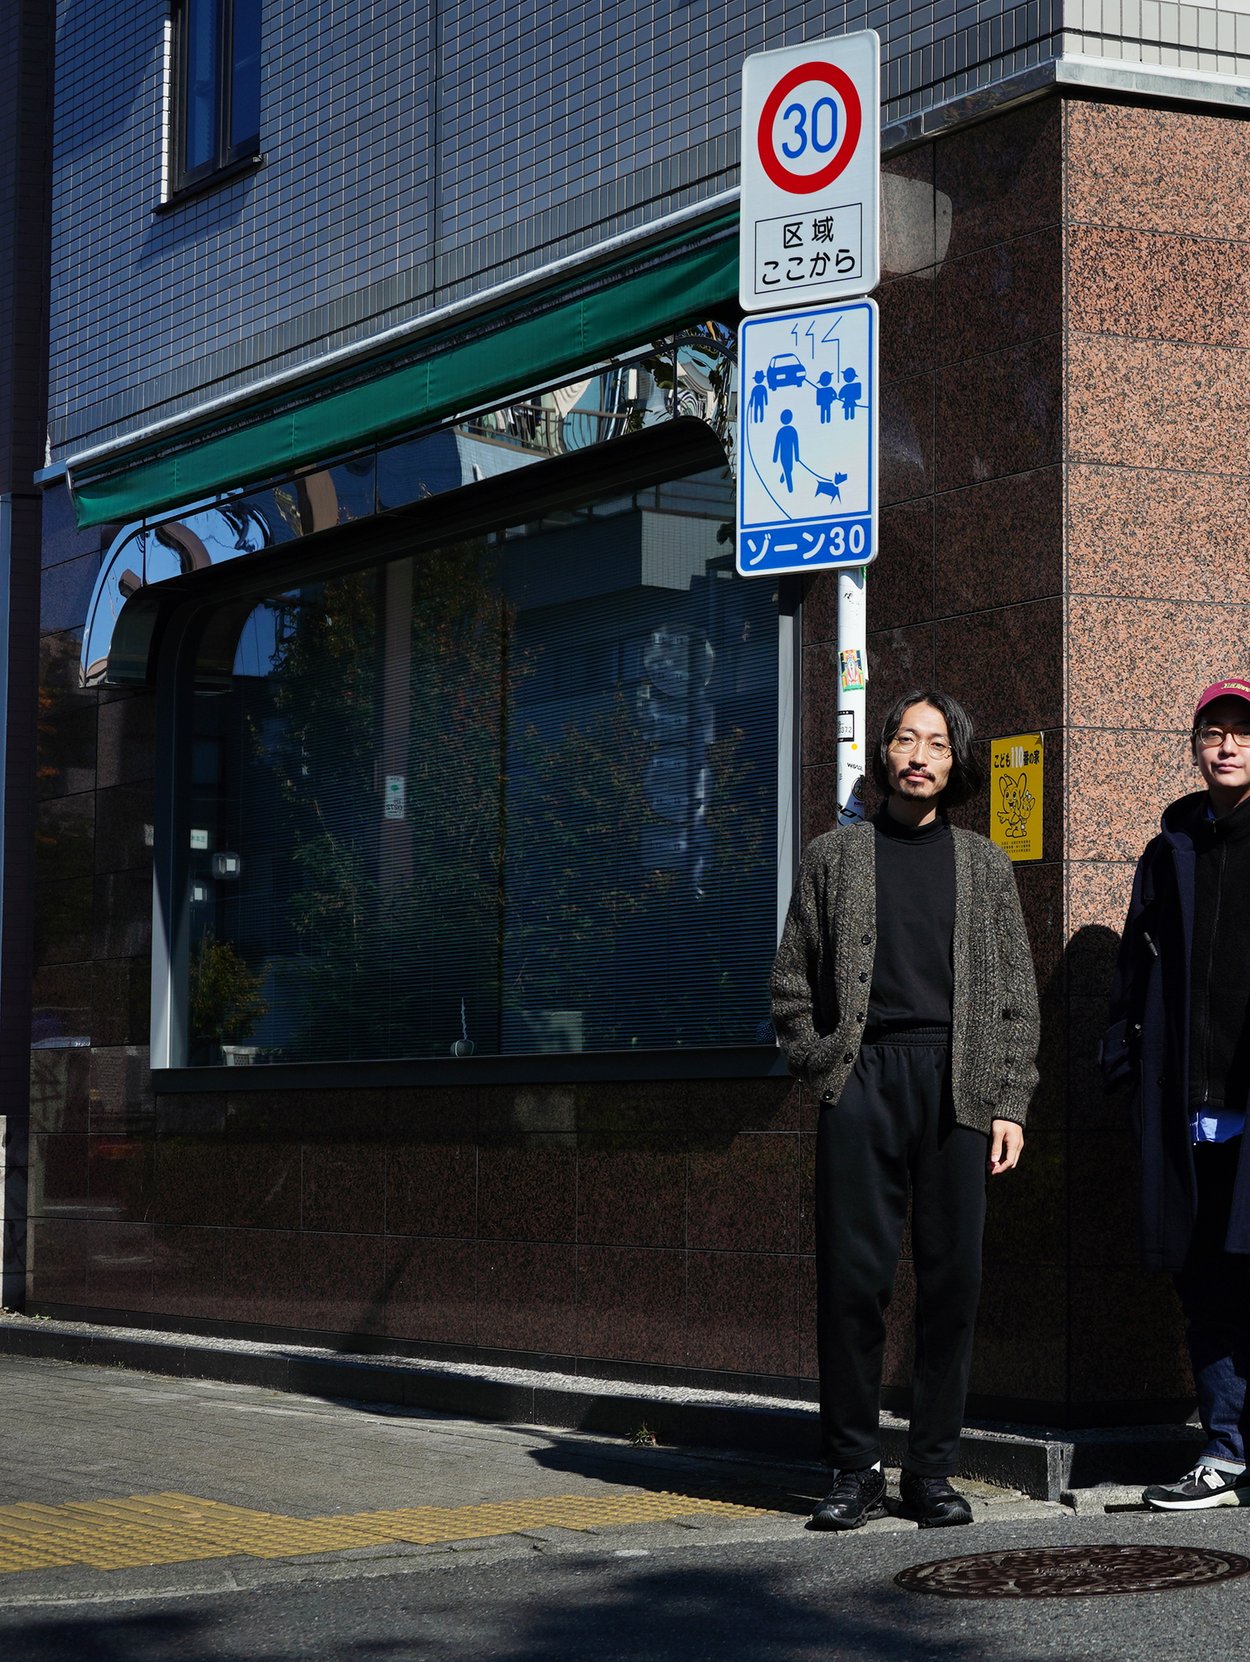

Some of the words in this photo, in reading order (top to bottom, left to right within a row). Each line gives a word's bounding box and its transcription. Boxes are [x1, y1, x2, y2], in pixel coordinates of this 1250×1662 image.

[782, 96, 838, 159] 30
[783, 215, 835, 249] 区域
[762, 248, 856, 285] ここから
[747, 524, 866, 566] ゾーン30
